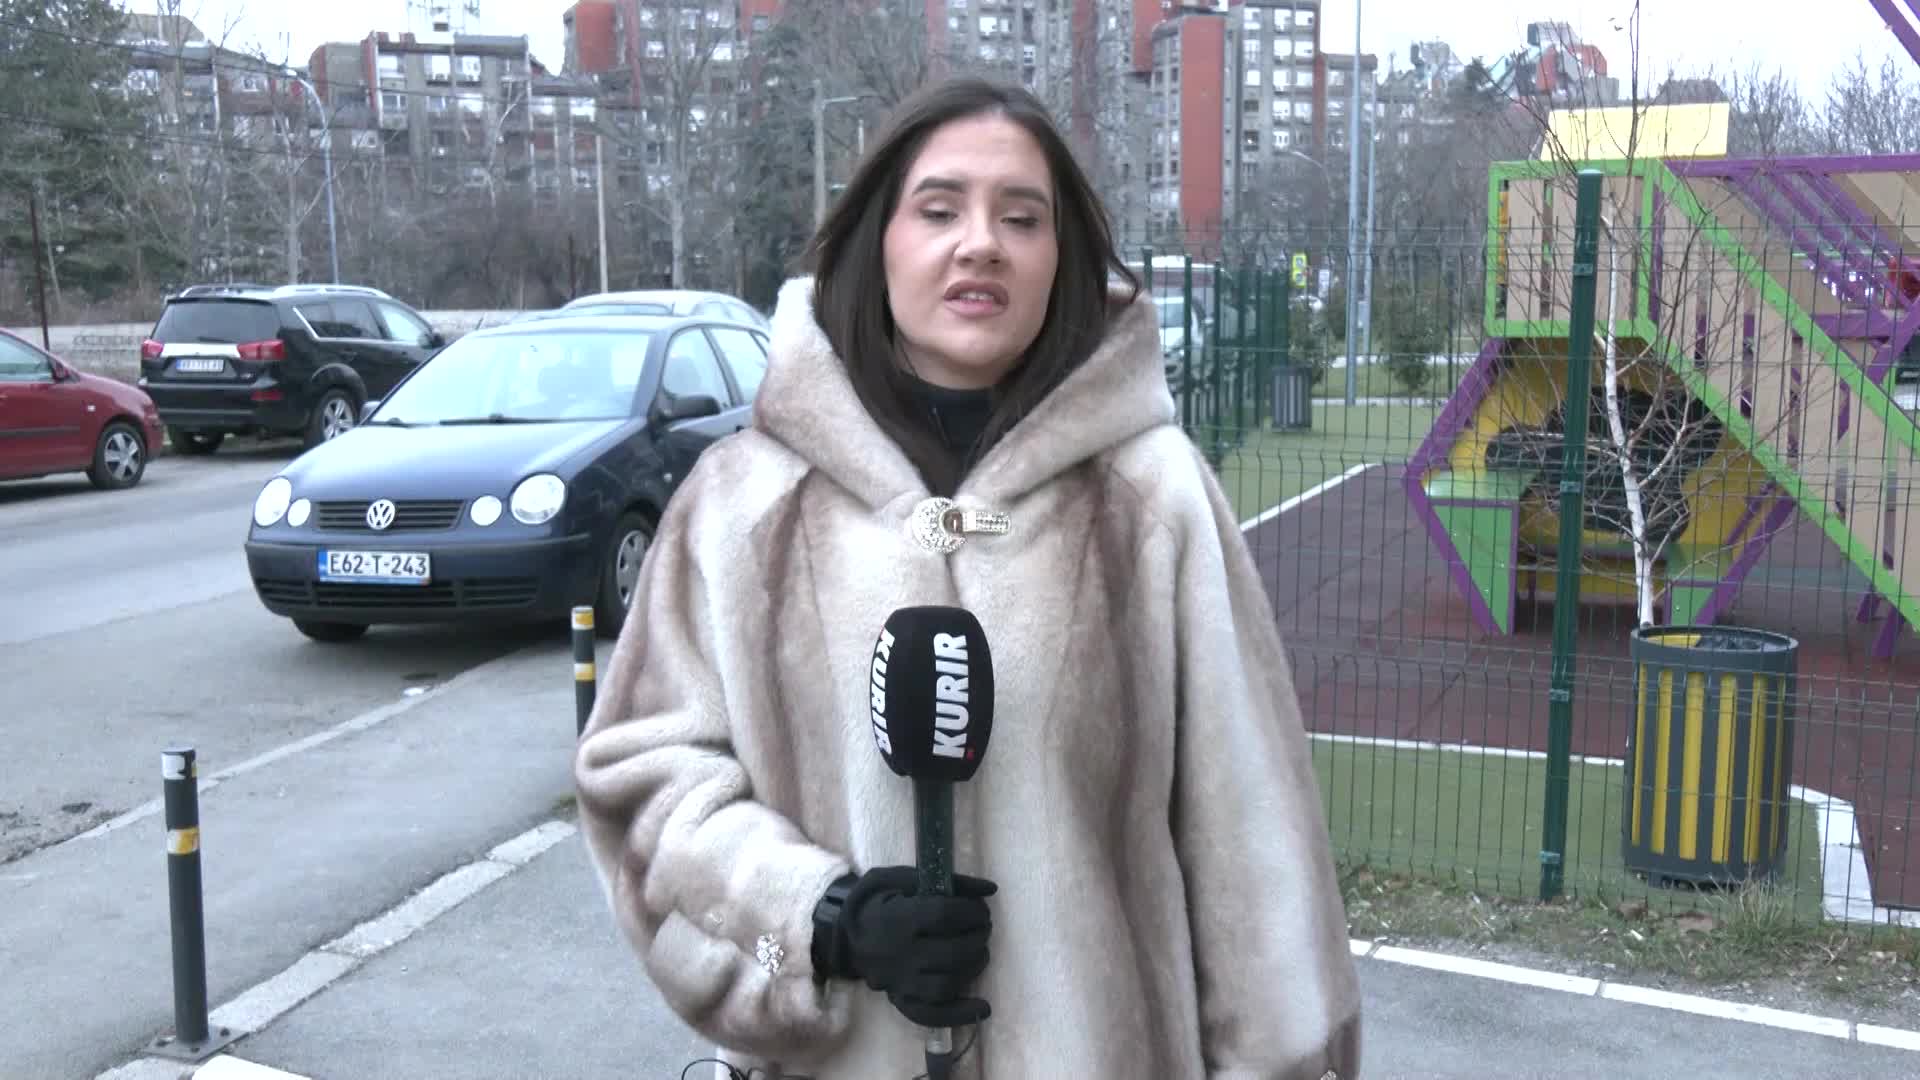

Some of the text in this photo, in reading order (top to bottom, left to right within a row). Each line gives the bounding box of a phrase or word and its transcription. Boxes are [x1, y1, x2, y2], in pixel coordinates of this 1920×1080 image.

[329, 553, 427, 576] E62-T-243
[871, 628, 895, 755] KURIR
[933, 633, 969, 758] KURIR
